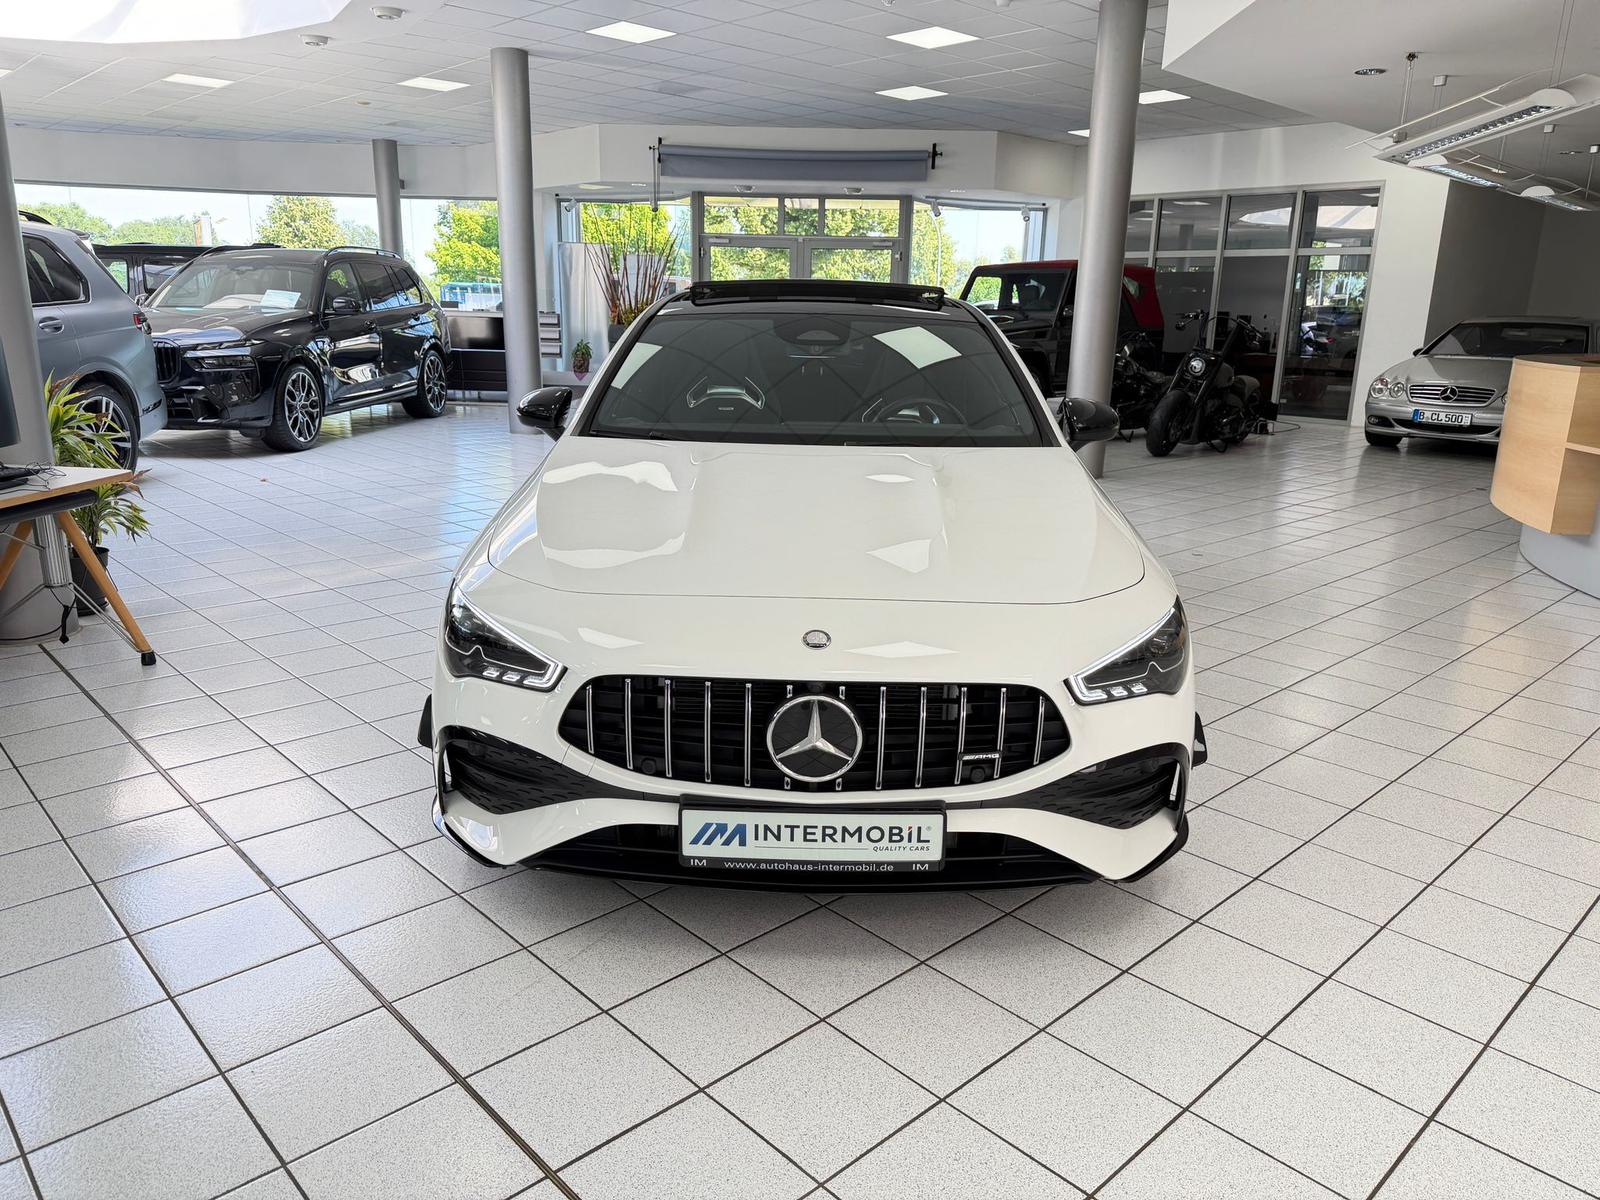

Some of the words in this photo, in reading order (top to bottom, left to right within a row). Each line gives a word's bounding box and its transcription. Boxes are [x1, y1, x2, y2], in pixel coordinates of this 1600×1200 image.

[1419, 411, 1425, 420] B
[1430, 412, 1443, 421] CL
[1444, 413, 1464, 423] 500
[872, 845, 908, 853] QUALITY
[690, 859, 708, 867] IM
[724, 861, 895, 872] www.autohaus-intermobil.de
[912, 863, 929, 871] IM
